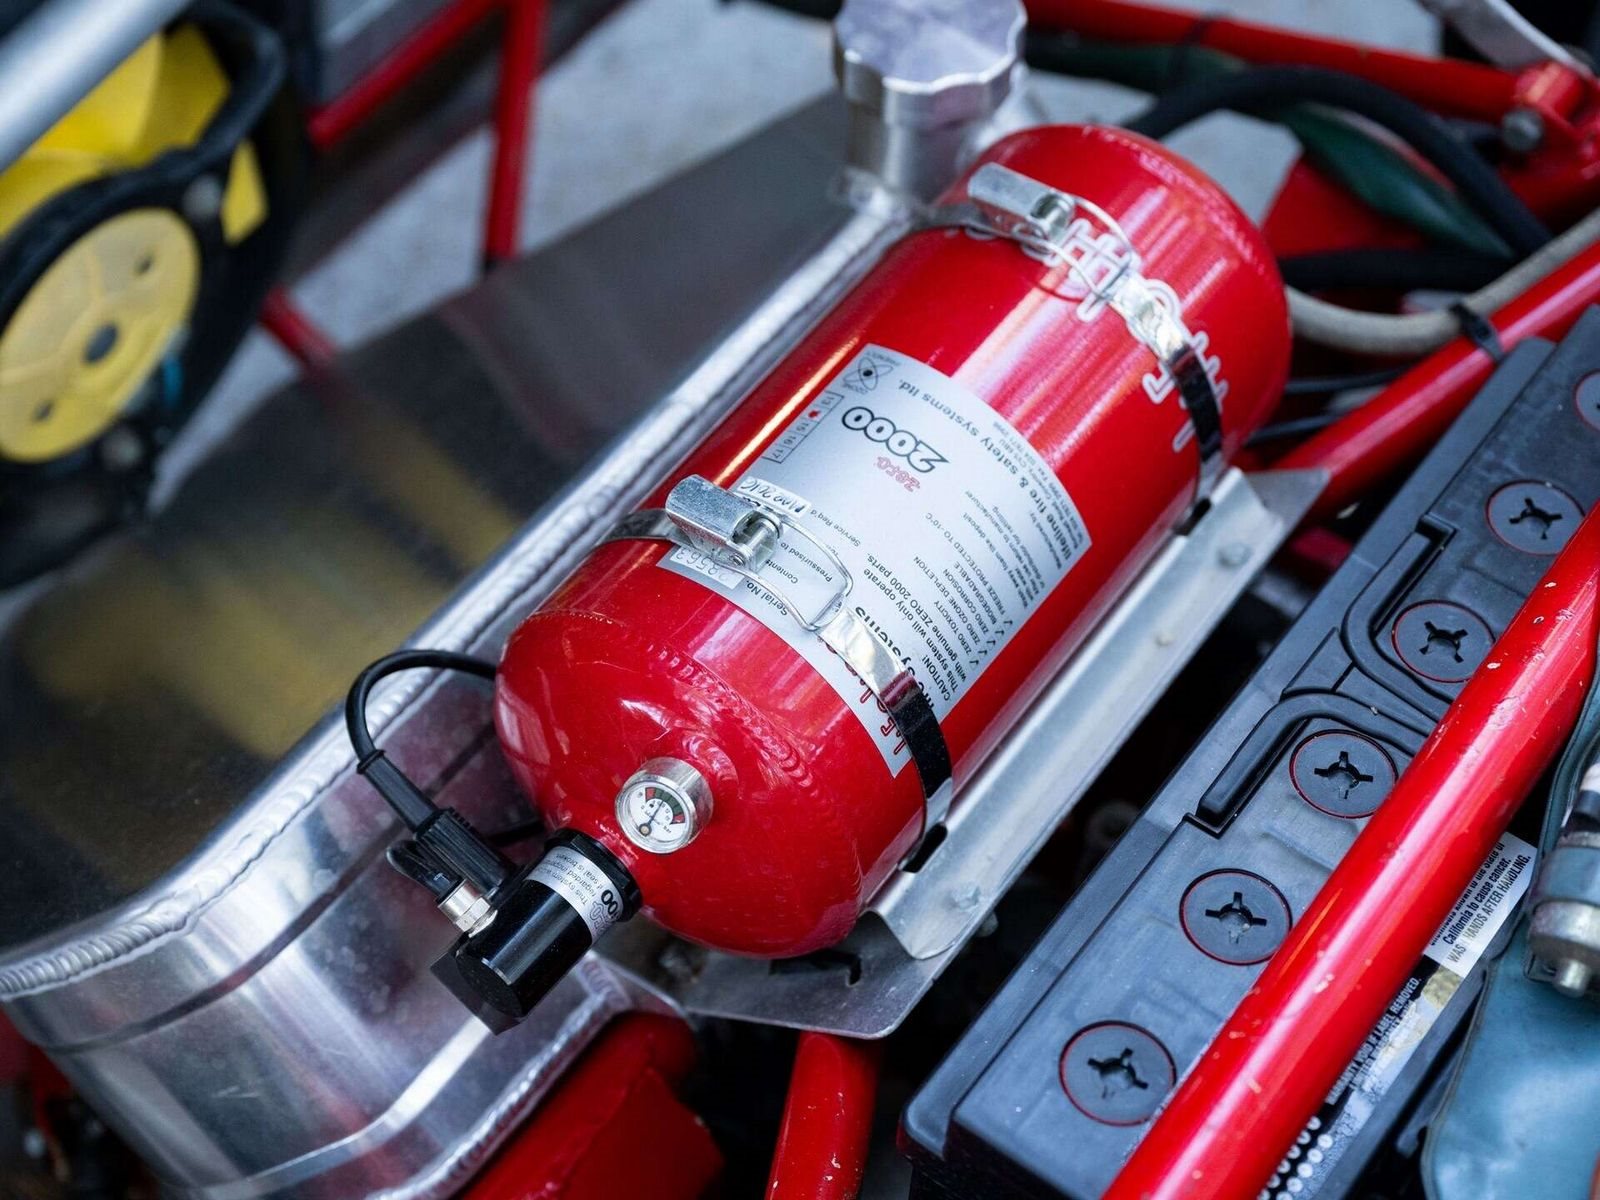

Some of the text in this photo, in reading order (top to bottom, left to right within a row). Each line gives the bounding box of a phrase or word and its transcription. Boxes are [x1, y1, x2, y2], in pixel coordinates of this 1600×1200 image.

[771, 447, 784, 458] 17
[842, 406, 949, 473] 2000
[895, 377, 1072, 559] lifeline fire & safety systems ltd.
[809, 508, 833, 527] Req'd
[961, 511, 986, 538] deposit
[963, 488, 1004, 536] manufacturer
[779, 541, 789, 550] to
[832, 523, 860, 547] Service
[941, 530, 954, 542] TO
[1001, 533, 1010, 543] to
[765, 558, 798, 584] Contents
[788, 547, 832, 582] Pressurised
[952, 541, 989, 586] PROTECTED
[743, 579, 789, 616] Serial No.
[861, 567, 897, 601] operate
[912, 555, 981, 645] ZERO OZONE DEPLETION
[941, 567, 989, 634] ZERO CORROSION
[952, 560, 997, 624] BIODEGRADABLE
[985, 585, 1006, 615] FREEZE
[863, 552, 968, 682] with genuine ZERO 2000 parts.
[894, 599, 915, 621] only
[933, 599, 972, 655] ZERO TOXICITY
[910, 620, 928, 638] will
[924, 636, 950, 670] system
[921, 654, 951, 701] CAUTION!
[943, 669, 960, 692] This
[551, 871, 575, 891] system
[566, 869, 596, 897] regarded
[582, 869, 598, 884] seal
[1442, 855, 1511, 946] California to cause cancer.
[1446, 936, 1470, 964] WAS
[1480, 889, 1504, 915] AFTER
[1496, 851, 1531, 893] HANDLING.
[1373, 1011, 1395, 1037] LABEL
[1389, 974, 1422, 1014] REMOVED.
